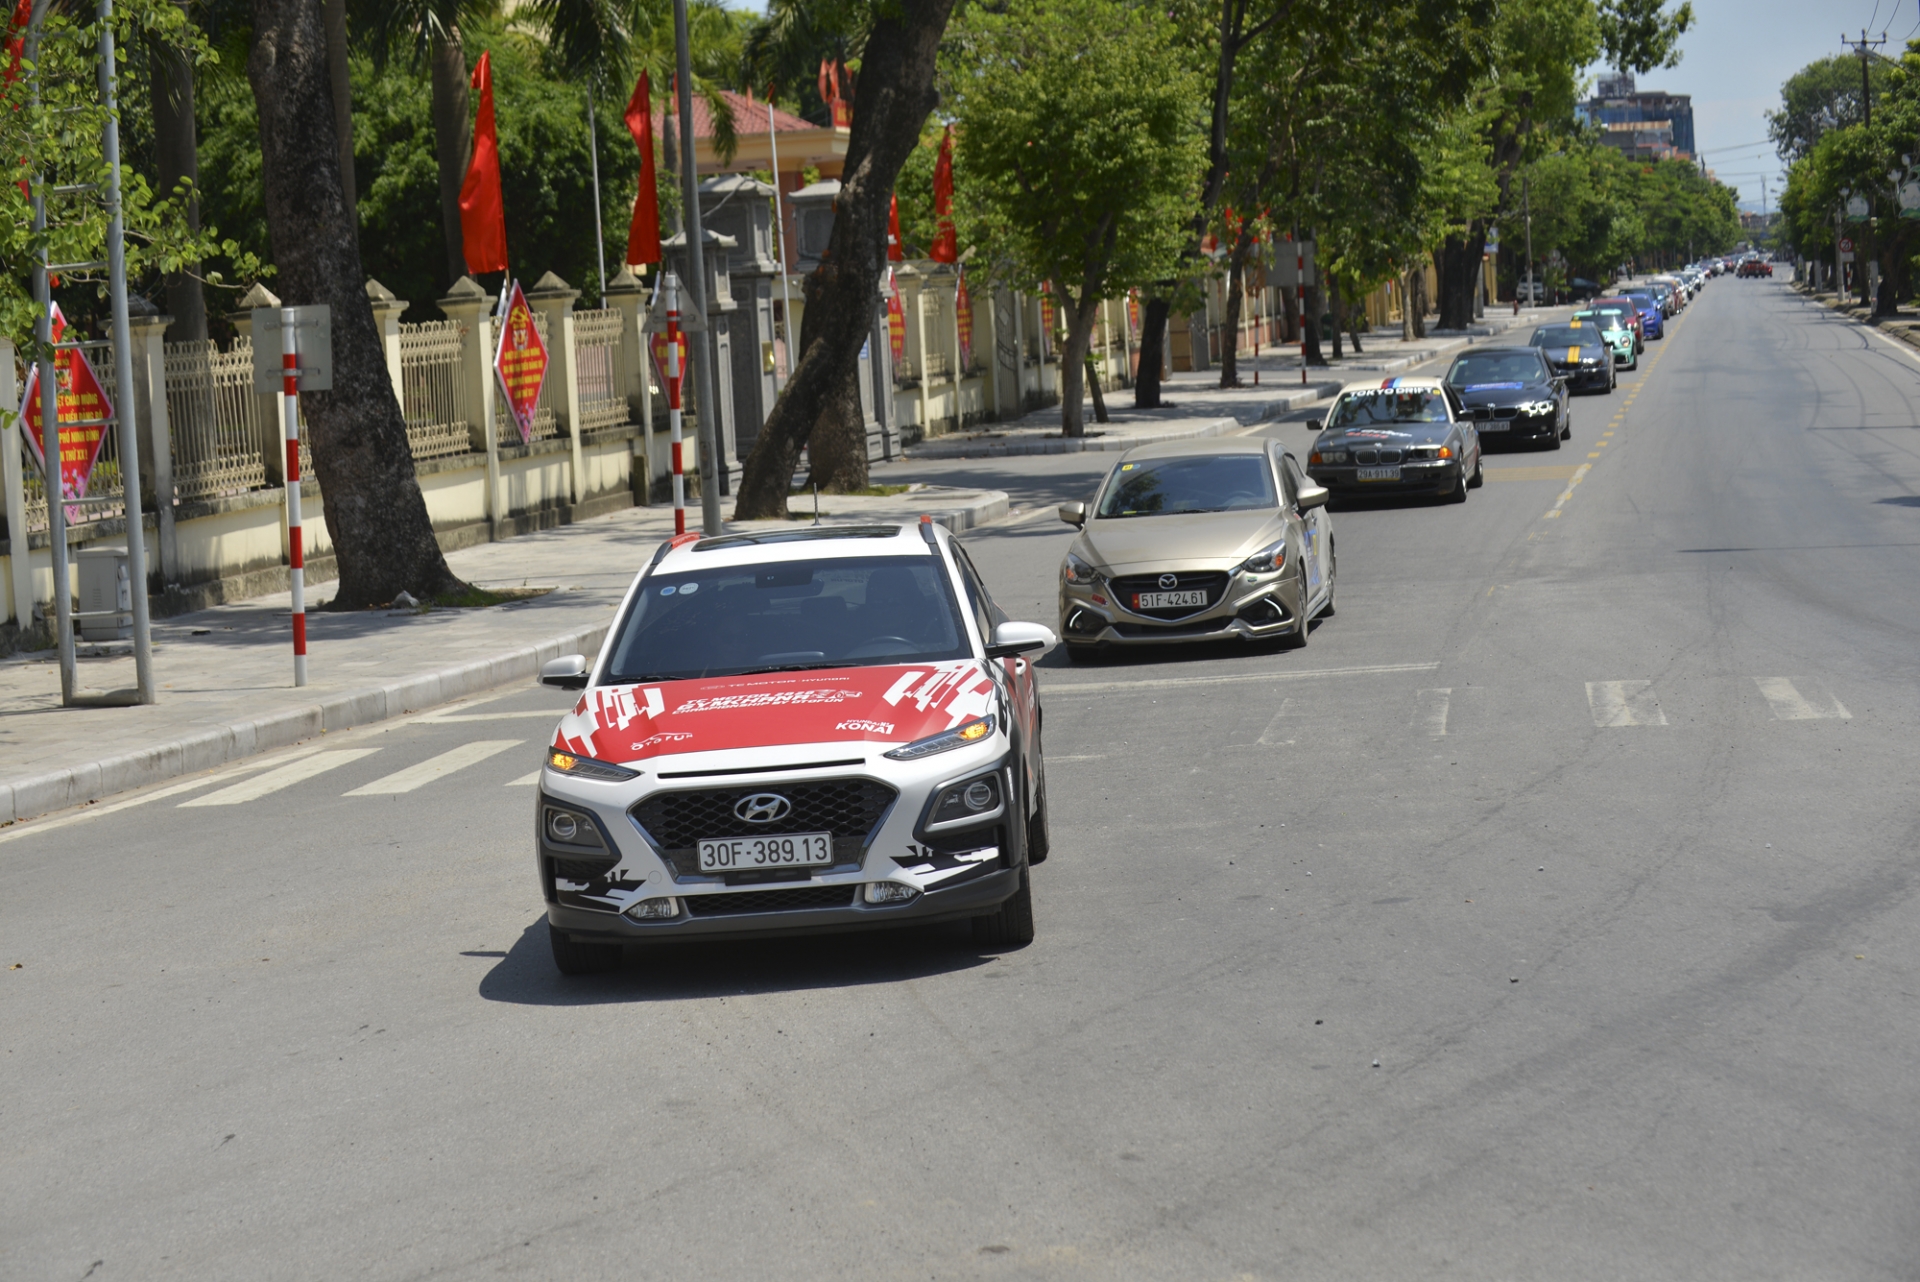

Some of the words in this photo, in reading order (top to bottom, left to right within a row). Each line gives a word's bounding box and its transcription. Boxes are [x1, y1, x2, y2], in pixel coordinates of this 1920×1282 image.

[1349, 387, 1394, 398] TOKYO
[1395, 386, 1433, 395] DRIFT
[1141, 591, 1204, 607] 51F-424.61
[746, 679, 797, 687] MOTOR
[677, 693, 813, 711] GYMKHANA
[710, 692, 772, 702] MOTOR
[672, 702, 770, 715] CHAMPIONSHIP
[702, 837, 828, 868] 30F-389.13
